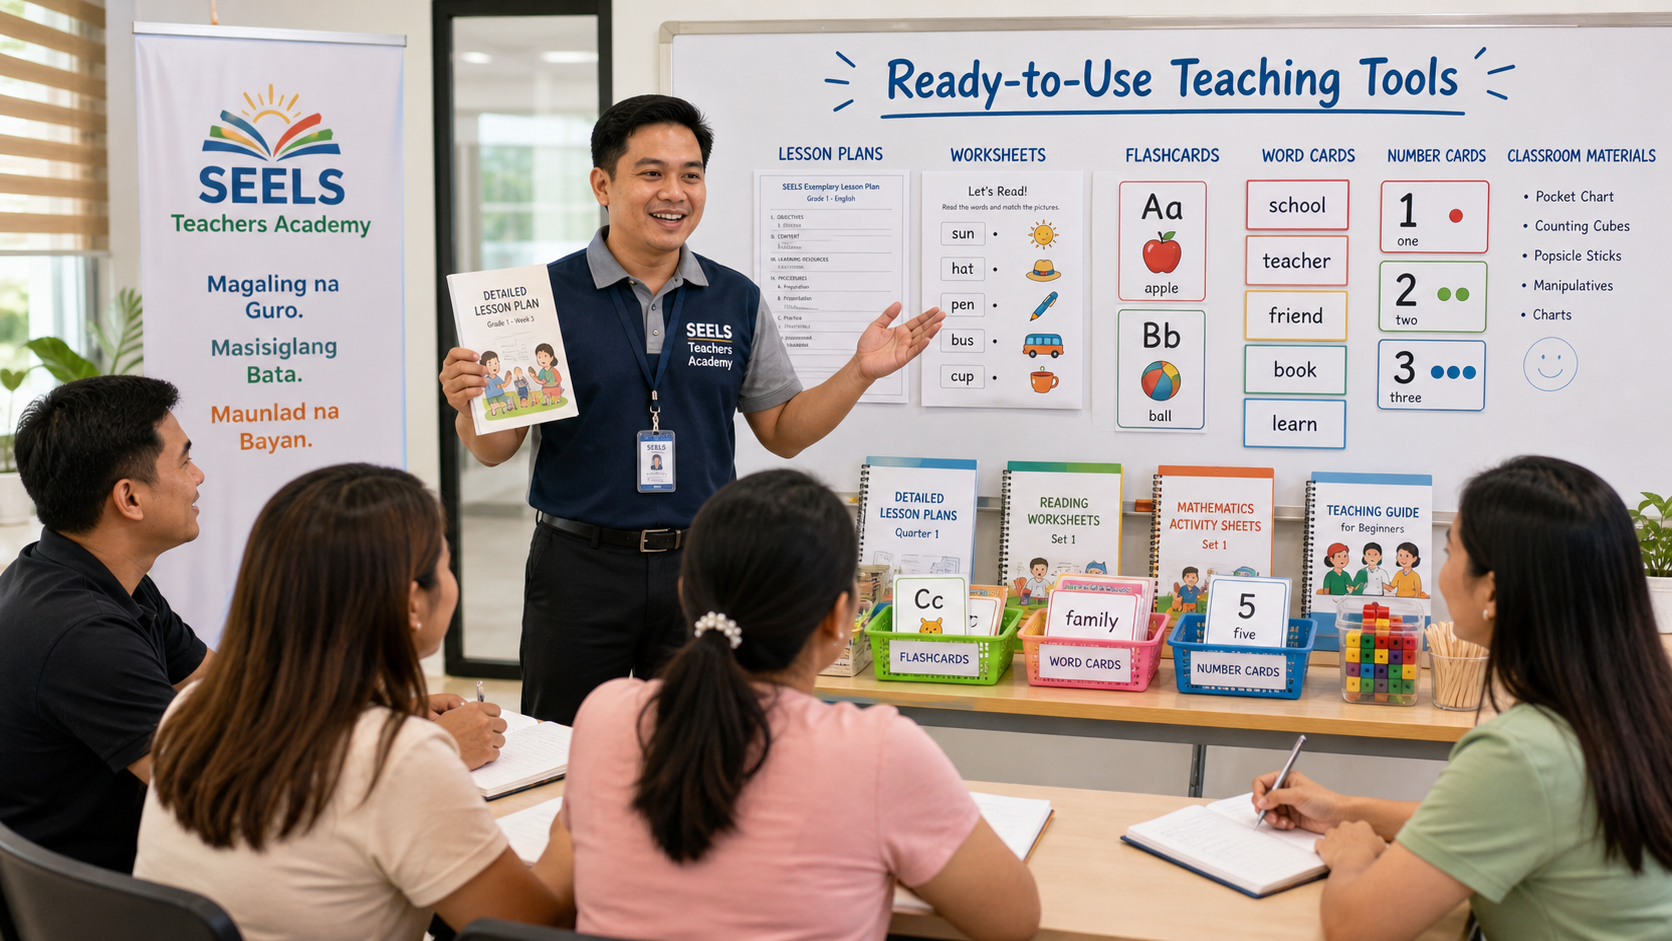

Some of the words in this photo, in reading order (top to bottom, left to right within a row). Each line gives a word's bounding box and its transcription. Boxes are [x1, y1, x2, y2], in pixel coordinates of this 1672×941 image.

[888, 59, 1153, 111] Ready-to-Use
[1171, 57, 1339, 108] Teaching
[1359, 56, 1457, 96] Tools
[779, 147, 831, 160] LESSON
[839, 147, 883, 160] PLANS
[951, 148, 1046, 162] WORKSHEETS
[1126, 148, 1219, 162] FLASHCARDS
[1262, 149, 1304, 162] WORD
[1310, 148, 1355, 162] CARDS
[1388, 149, 1440, 162] NUMBER
[1446, 149, 1486, 162] CARDS
[1508, 149, 1580, 162] CLASSROOM
[1587, 149, 1656, 162] MATERIALS
[199, 166, 345, 205] SEELS
[804, 183, 839, 191] Exemplary
[969, 186, 993, 196] Let's
[998, 186, 1027, 196] Read!
[835, 195, 855, 203] English
[1537, 191, 1575, 202] Pocket
[1582, 191, 1614, 202] Chart
[1034, 204, 1060, 212] pictures.
[1142, 193, 1182, 219] Aa
[1270, 196, 1325, 213] school
[1400, 193, 1416, 227] 1
[171, 214, 267, 232] Teachers
[274, 215, 371, 238] Academy
[1536, 220, 1588, 235] Counting
[1594, 220, 1630, 231] Cubes
[952, 230, 974, 239] sun
[1398, 238, 1418, 246] one
[1263, 252, 1331, 268] teacher
[1535, 250, 1581, 264] Popsicle
[1587, 250, 1621, 261] Sticks
[952, 262, 973, 274] hat
[208, 275, 306, 297] Magaling
[315, 279, 338, 292] na
[1145, 282, 1178, 296] apple
[1396, 273, 1416, 306] 2
[1534, 279, 1613, 294] Manipulatives
[483, 287, 526, 300] DETAILED
[246, 302, 303, 319] Guro.
[475, 302, 511, 316] LESSON
[514, 299, 539, 310] PLAN
[952, 301, 974, 312] pen
[1269, 307, 1322, 323] friend
[1396, 315, 1417, 325] two
[1533, 309, 1571, 320] Charts
[487, 320, 504, 328] Grade
[687, 323, 732, 340] SEELS
[1144, 322, 1180, 348] Bb
[952, 335, 973, 346] bus
[212, 337, 336, 360] Masisiglang
[688, 342, 732, 354] Teachers
[688, 356, 732, 370] Academy
[1275, 361, 1316, 377] book
[1394, 351, 1415, 384] 3
[248, 366, 302, 383] Bata.
[951, 373, 974, 384] cup
[1390, 392, 1421, 403] three
[212, 402, 305, 423] Maunlad
[314, 406, 338, 419] na
[1150, 410, 1171, 421] ball
[1273, 415, 1316, 431] learn
[241, 433, 312, 454] Bayan.
[895, 492, 944, 503] DETAILED
[1041, 497, 1088, 508] READING
[880, 508, 919, 519] LESSON
[924, 510, 957, 521] PLANS
[1178, 502, 1254, 514] MATHEMATICS
[1327, 505, 1381, 516] TEACHING
[1386, 507, 1419, 518] GUIDE
[1028, 514, 1100, 526] WORKSHEETS
[1170, 519, 1217, 530] ACTIVITY
[1221, 520, 1261, 531] SHEETS
[895, 528, 931, 538] Quarter
[936, 530, 938, 538] 1
[1341, 523, 1355, 531] for
[1359, 523, 1404, 535] Beginners
[1052, 534, 1067, 544] Set
[1072, 535, 1076, 544] 1
[1203, 539, 1218, 549] Set
[1222, 541, 1226, 549] 1
[915, 589, 943, 609] Cc
[1239, 593, 1255, 619] 5
[1066, 610, 1118, 632] family
[1234, 627, 1255, 639] five
[900, 652, 969, 664] FLASHCARDS
[1050, 656, 1082, 667] WORD
[1086, 659, 1121, 670] CARDS
[1197, 664, 1241, 675] NUMBER
[1245, 666, 1279, 677] CARDS
